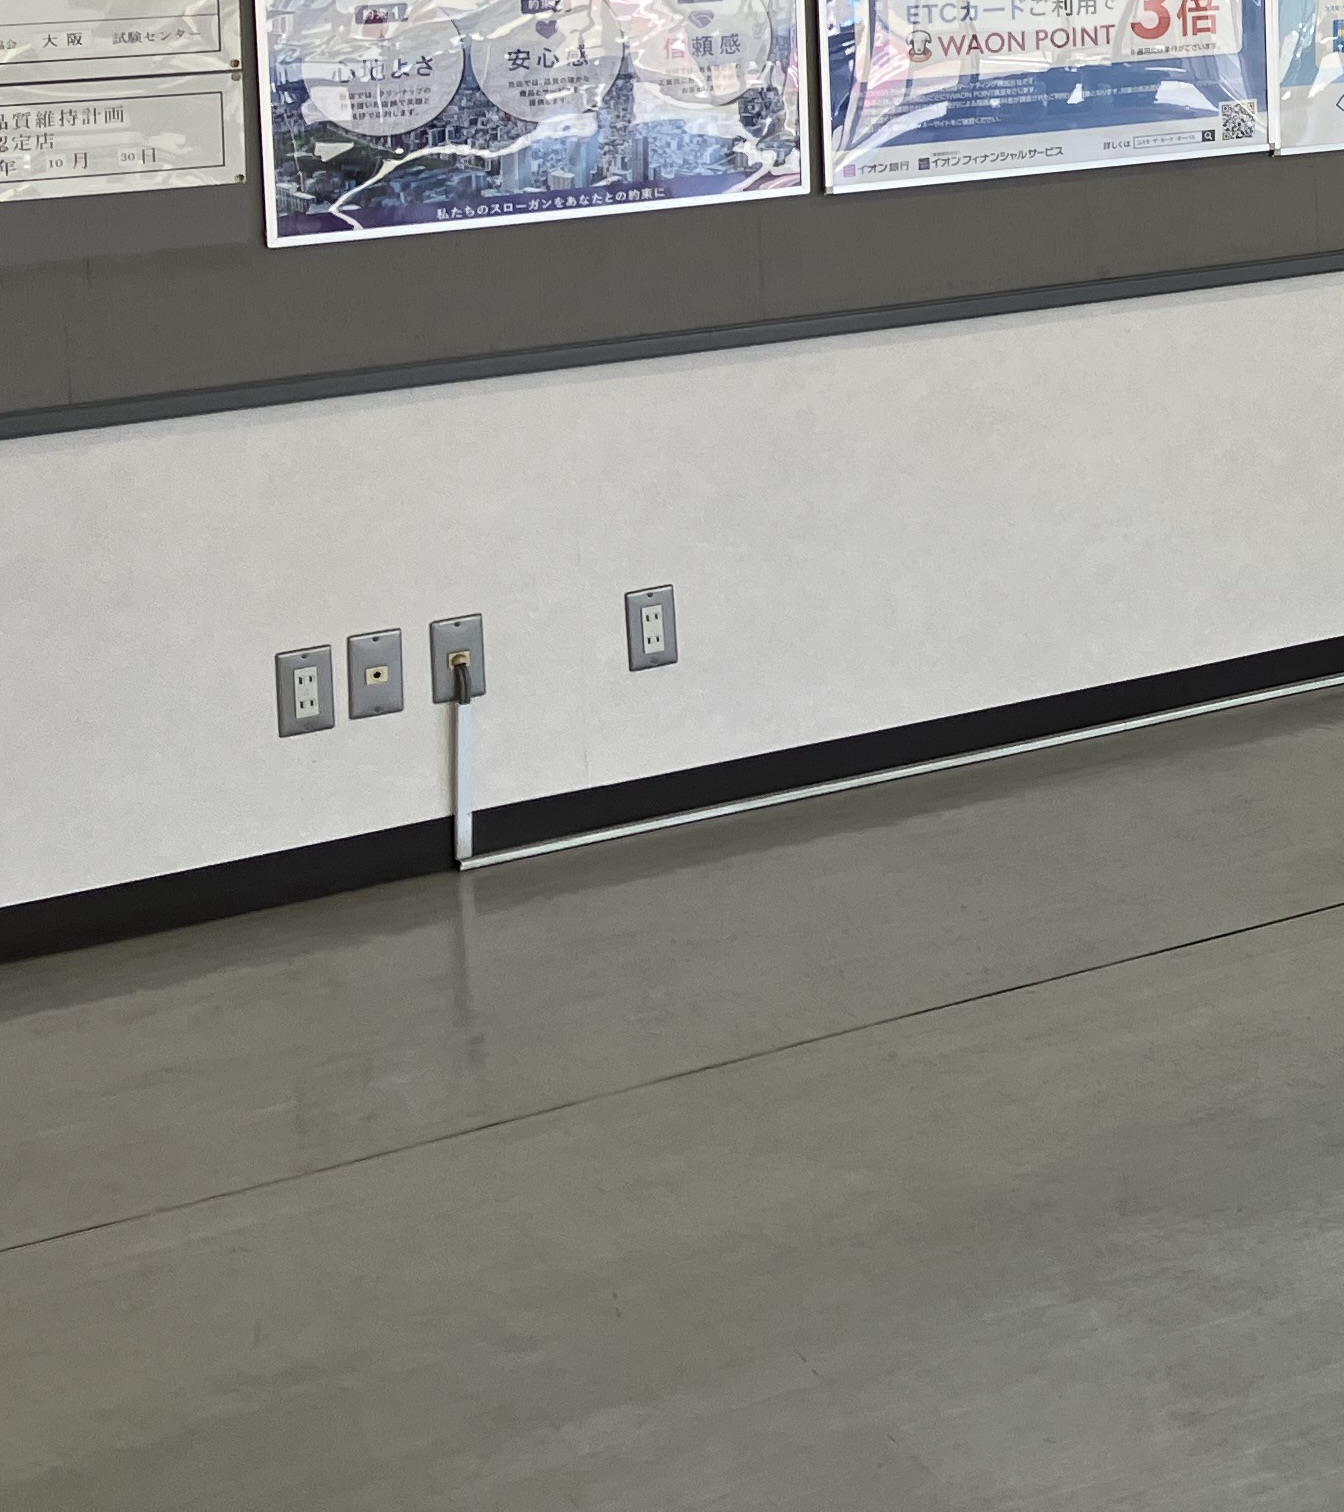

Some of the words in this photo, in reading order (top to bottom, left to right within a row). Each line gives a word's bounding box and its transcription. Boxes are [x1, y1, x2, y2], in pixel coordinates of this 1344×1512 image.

[42, 32, 83, 48] 大阪
[112, 28, 201, 45] 試験センター
[938, 30, 1028, 57] WAON
[1034, 23, 1116, 51] POINT
[1102, 139, 1131, 150] 詳しくは
[49, 158, 64, 169] 10
[73, 152, 88, 170] 月
[120, 152, 136, 162] 30
[141, 147, 156, 165] 日
[857, 160, 911, 174] イオン銀行
[930, 146, 1064, 168] イオンフィナンシャルサービス
[436, 187, 667, 220] 私たちのスローガンをあなたとの約束に
